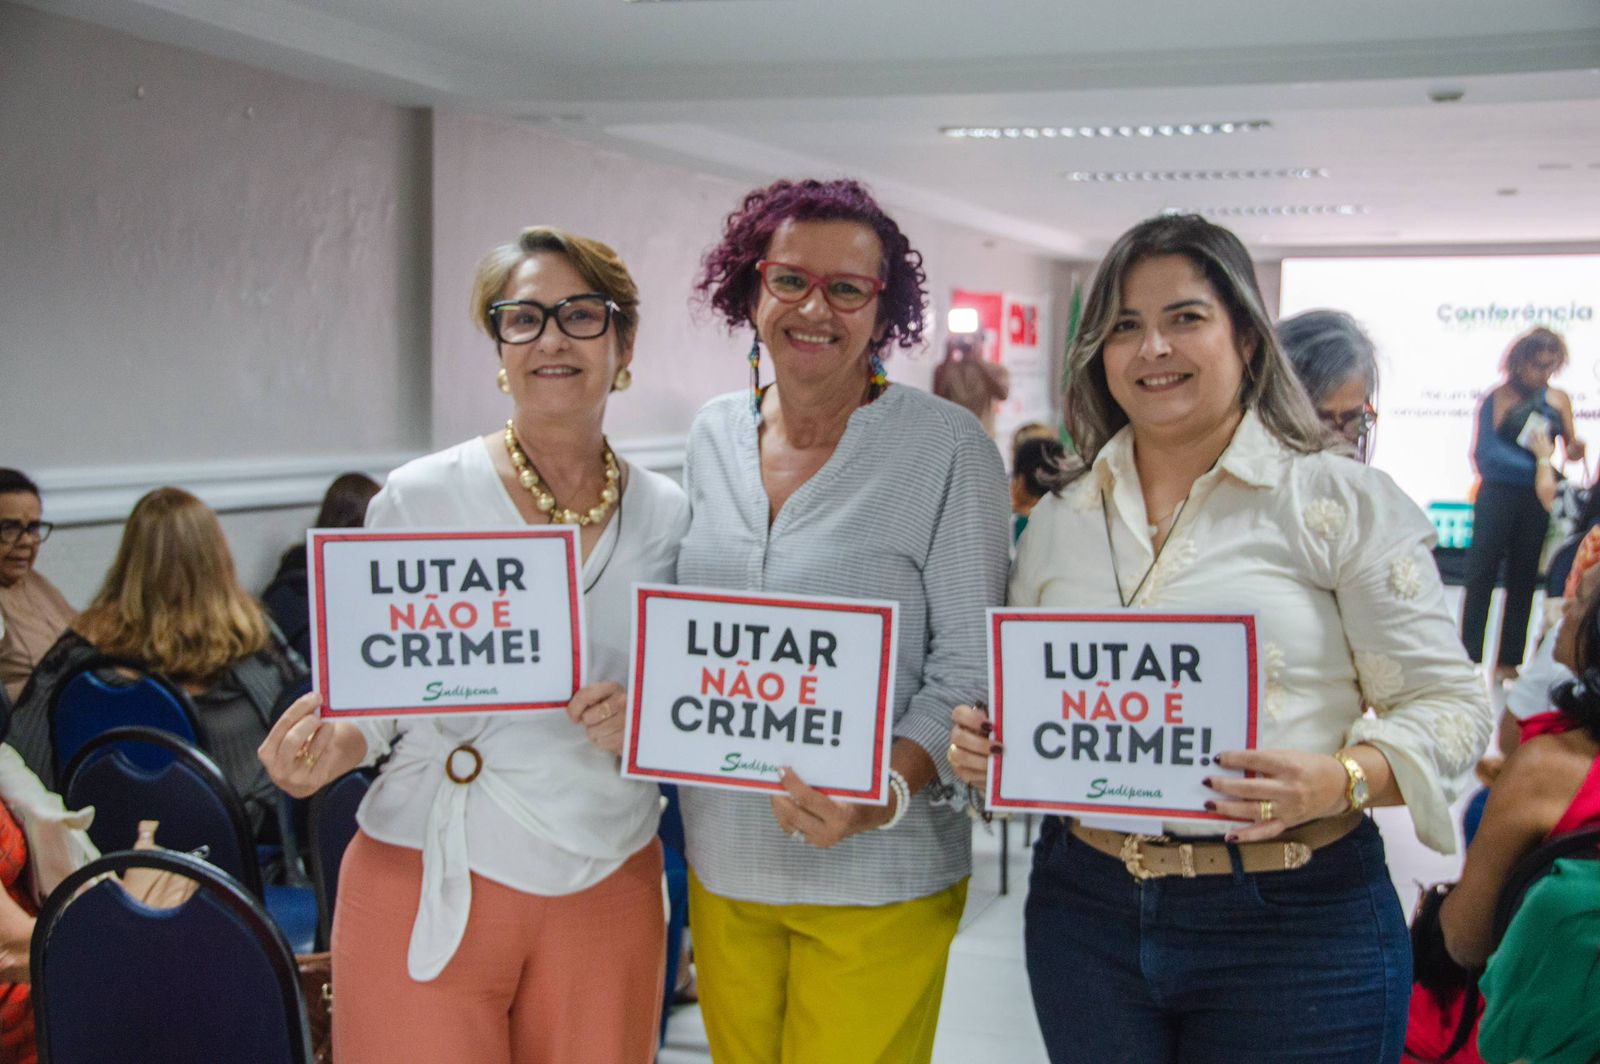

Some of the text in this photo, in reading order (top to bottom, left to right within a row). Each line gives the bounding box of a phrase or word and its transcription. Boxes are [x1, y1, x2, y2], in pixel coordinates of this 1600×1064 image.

[370, 558, 526, 594] LUTAR
[389, 590, 512, 632] NÃO É
[360, 629, 541, 669] CRIME!
[687, 619, 838, 668] LUTAR
[1044, 642, 1202, 683] LUTAR
[422, 681, 499, 701] Sindipema
[700, 659, 818, 706] NÃO É
[1062, 680, 1184, 725] NÃO É
[671, 695, 843, 747] CRIME!
[1033, 722, 1212, 767] CRIME!
[1086, 777, 1164, 800] Sindipema
